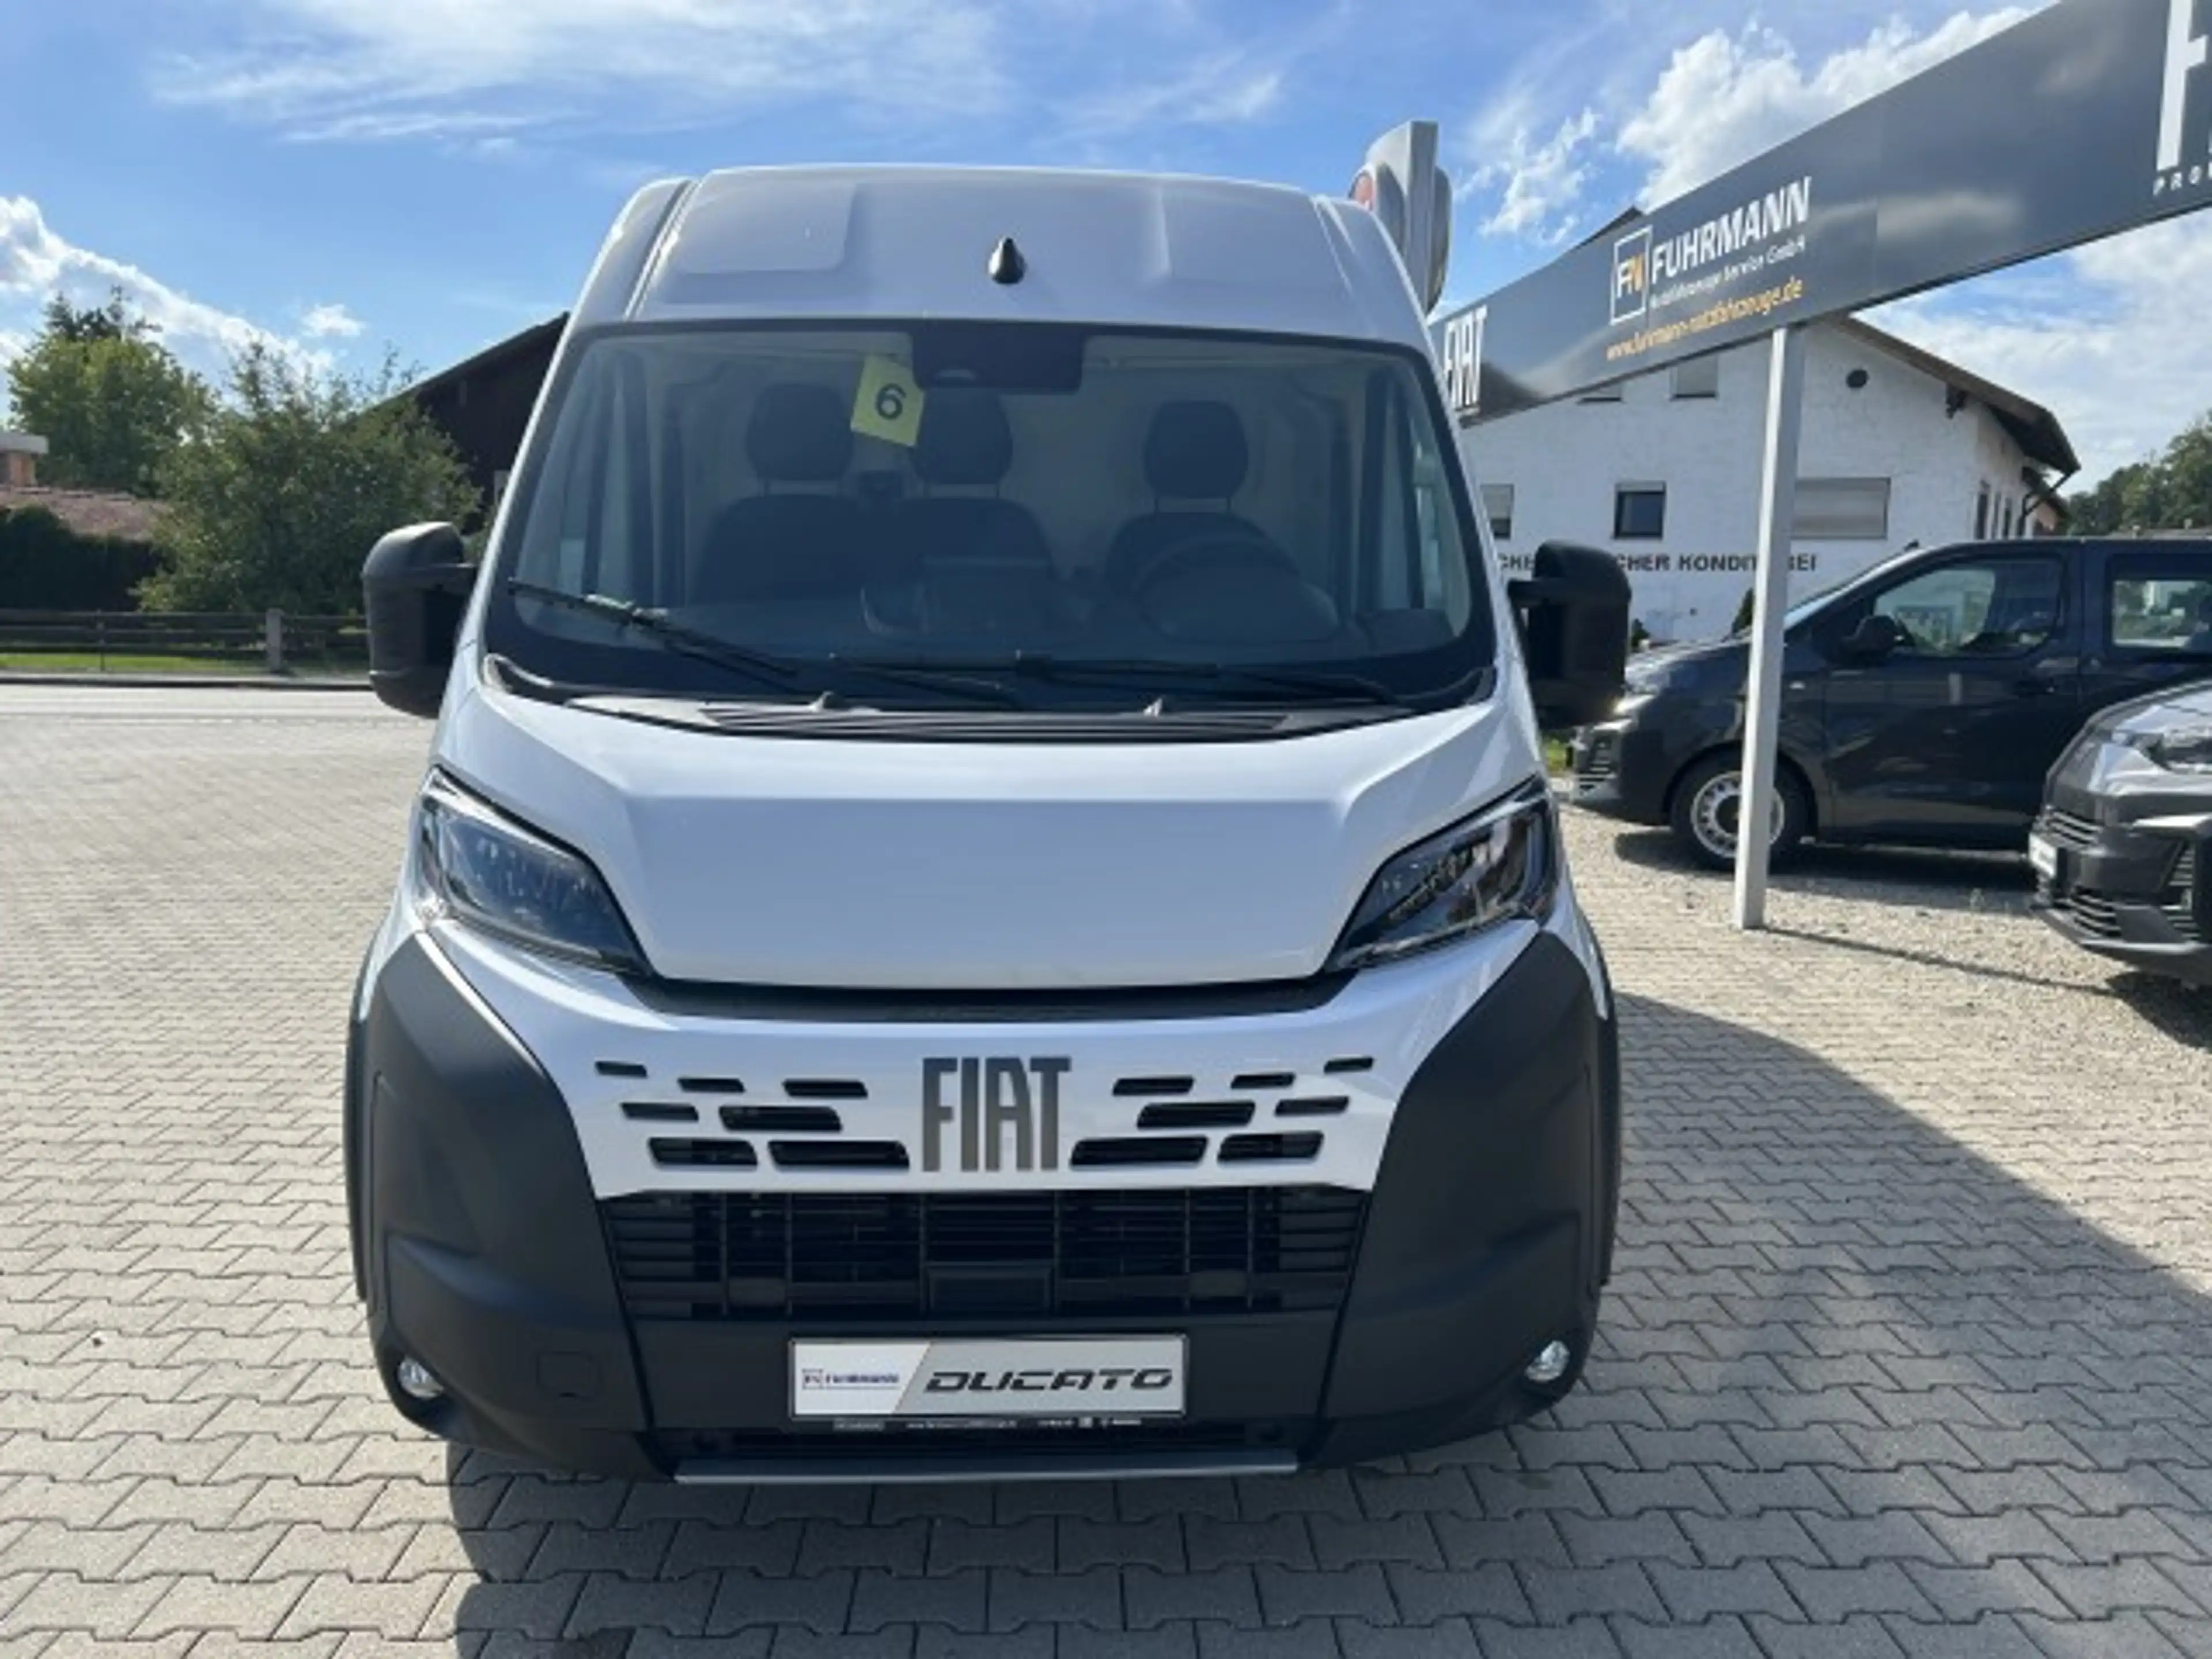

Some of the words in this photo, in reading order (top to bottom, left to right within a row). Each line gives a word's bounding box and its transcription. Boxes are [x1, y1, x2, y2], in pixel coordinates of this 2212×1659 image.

[1652, 175, 1812, 285] FUHRMANN
[1444, 305, 1487, 409] FIAT
[874, 382, 907, 421] 6
[1678, 553, 1817, 572] KONDITEI
[922, 1056, 1072, 1172] FIAT
[924, 1368, 1173, 1392] DUCATO
